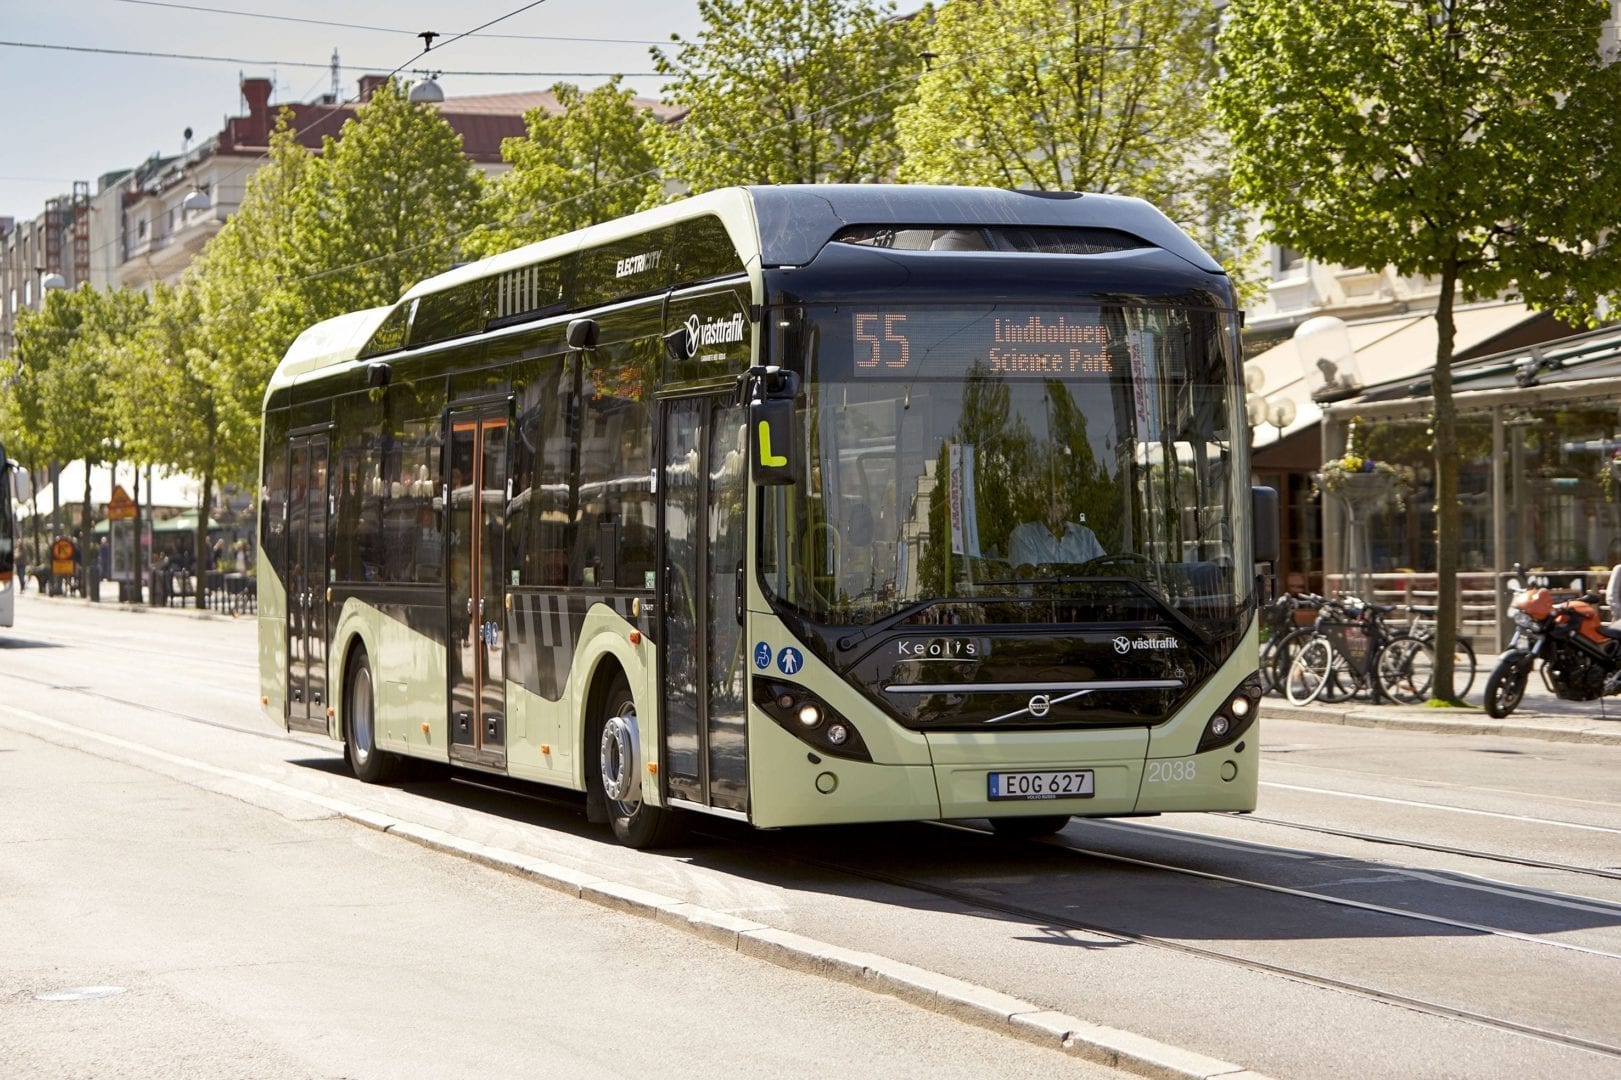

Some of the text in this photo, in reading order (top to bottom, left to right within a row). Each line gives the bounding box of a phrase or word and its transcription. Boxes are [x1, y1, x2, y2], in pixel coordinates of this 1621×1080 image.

[616, 250, 662, 278] ELECTRICITY
[700, 312, 745, 345] västtrafik
[856, 313, 910, 368] 55
[994, 316, 1107, 343] Lindholmen
[989, 345, 1113, 372] Science Park
[898, 641, 975, 655] Keolis
[1131, 637, 1179, 650] västtrafik
[1007, 774, 1085, 794] EOG 627
[1148, 760, 1196, 782] 2038
